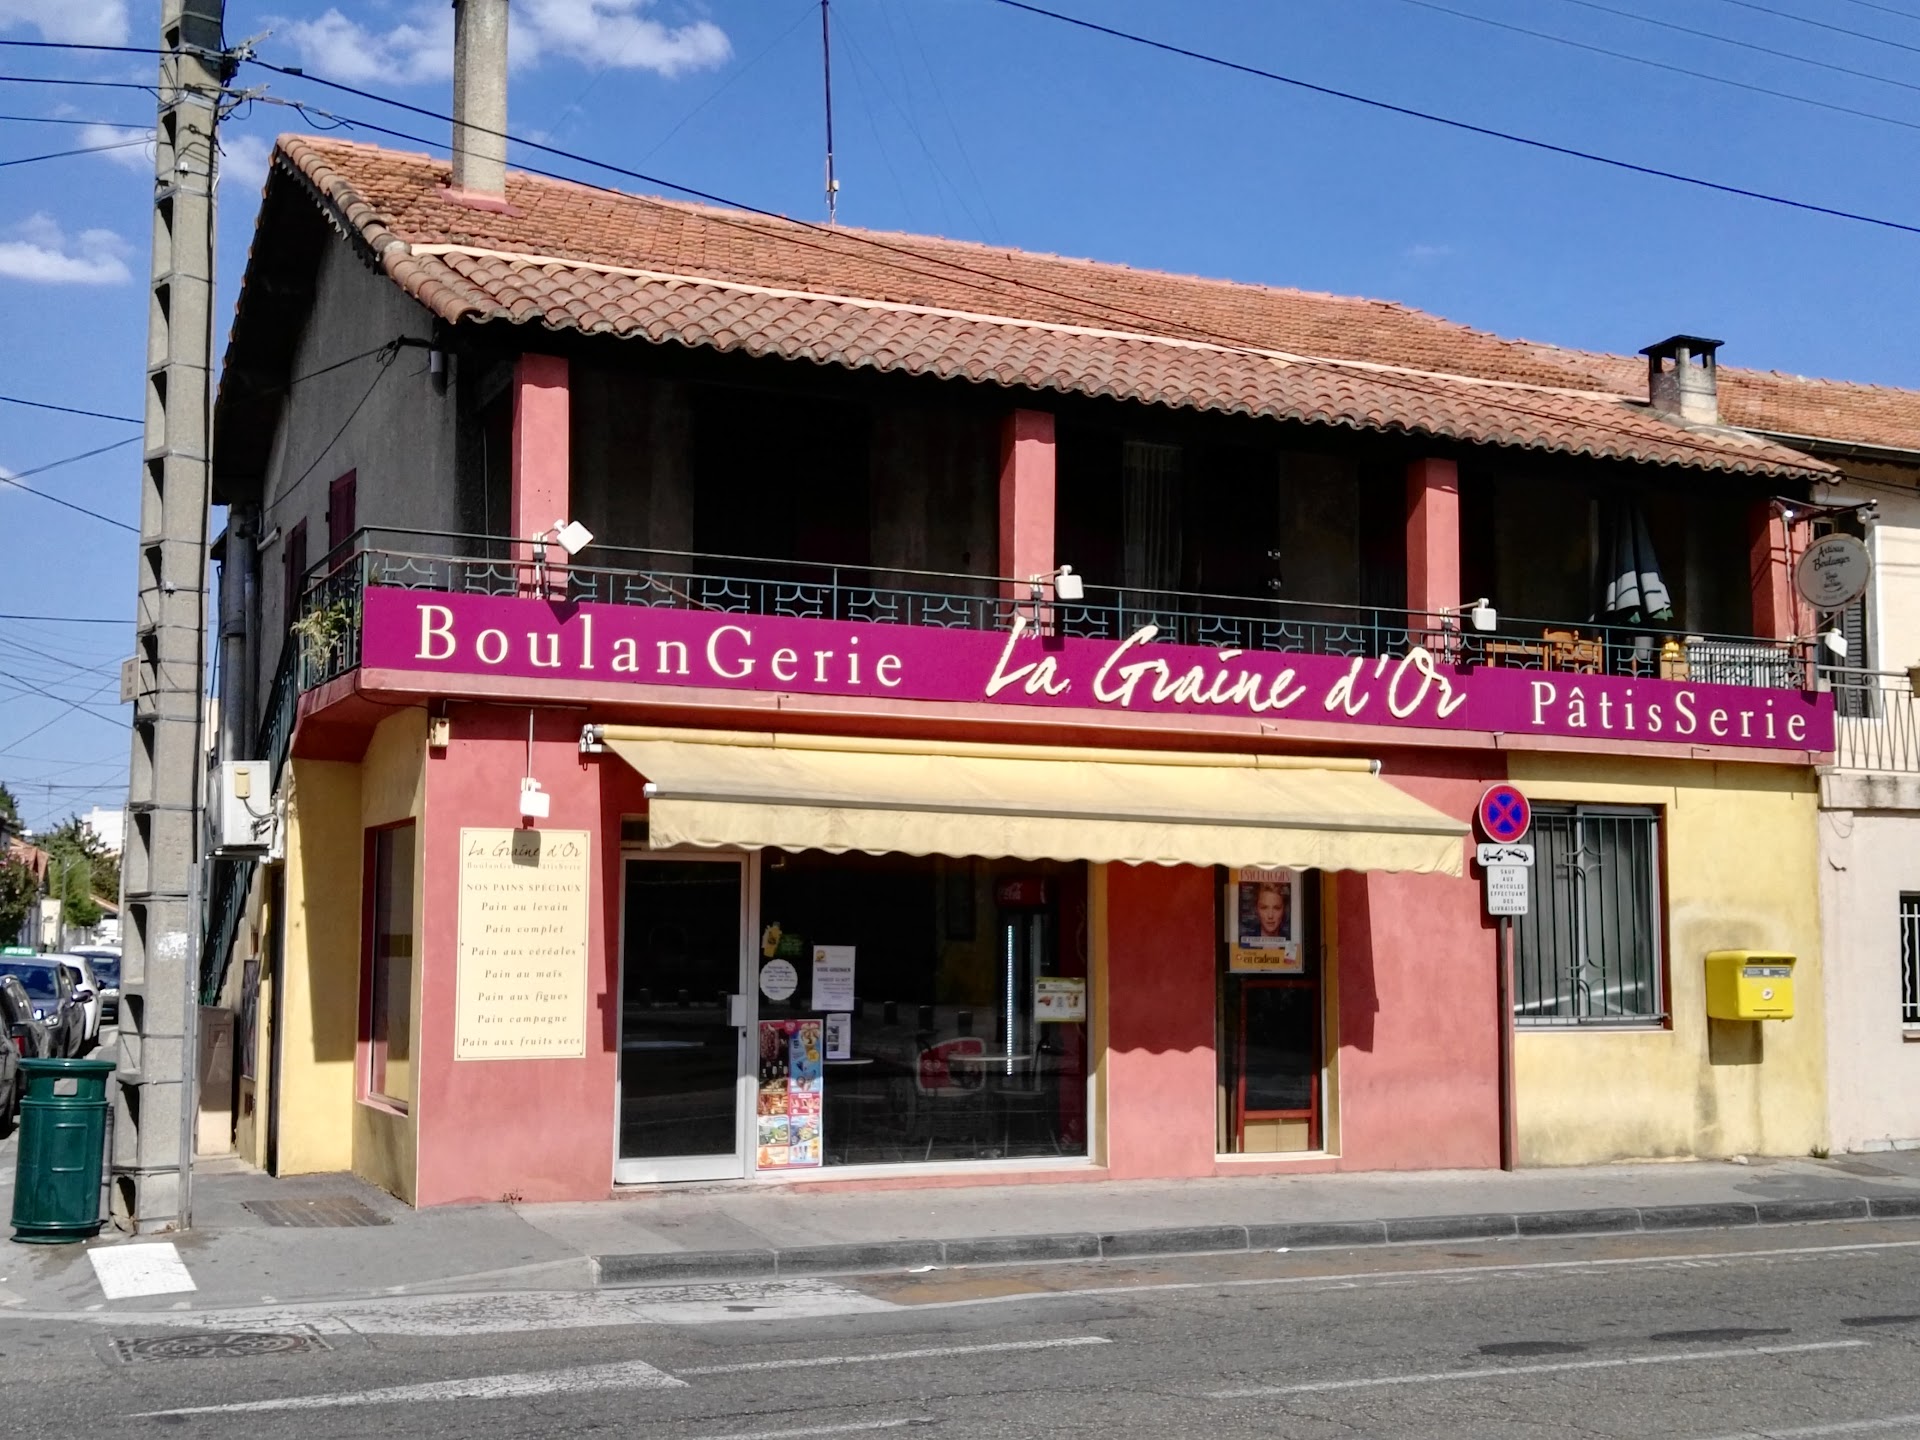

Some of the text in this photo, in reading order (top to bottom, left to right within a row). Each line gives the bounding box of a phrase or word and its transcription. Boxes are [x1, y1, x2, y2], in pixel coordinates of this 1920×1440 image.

[415, 604, 902, 687] BoulanGerie
[986, 616, 1071, 697] La
[1325, 646, 1466, 718] d'Or
[1531, 681, 1807, 742] PâtisSerie
[468, 840, 486, 856] La
[547, 842, 581, 857] d'Or
[493, 884, 524, 892] PAINS
[482, 902, 507, 911] Pain
[533, 902, 568, 911] levain
[485, 924, 564, 935] Pain complet
[472, 947, 576, 956] Pain aux céréales
[1254, 954, 1280, 964] cadeau
[485, 970, 510, 978] Pain
[536, 970, 562, 978] maïs
[478, 992, 504, 1001] Pain
[535, 991, 568, 1002] figues
[478, 1015, 567, 1024] Pain campagne
[462, 1038, 488, 1046] Pain
[520, 1037, 552, 1047] fruits
